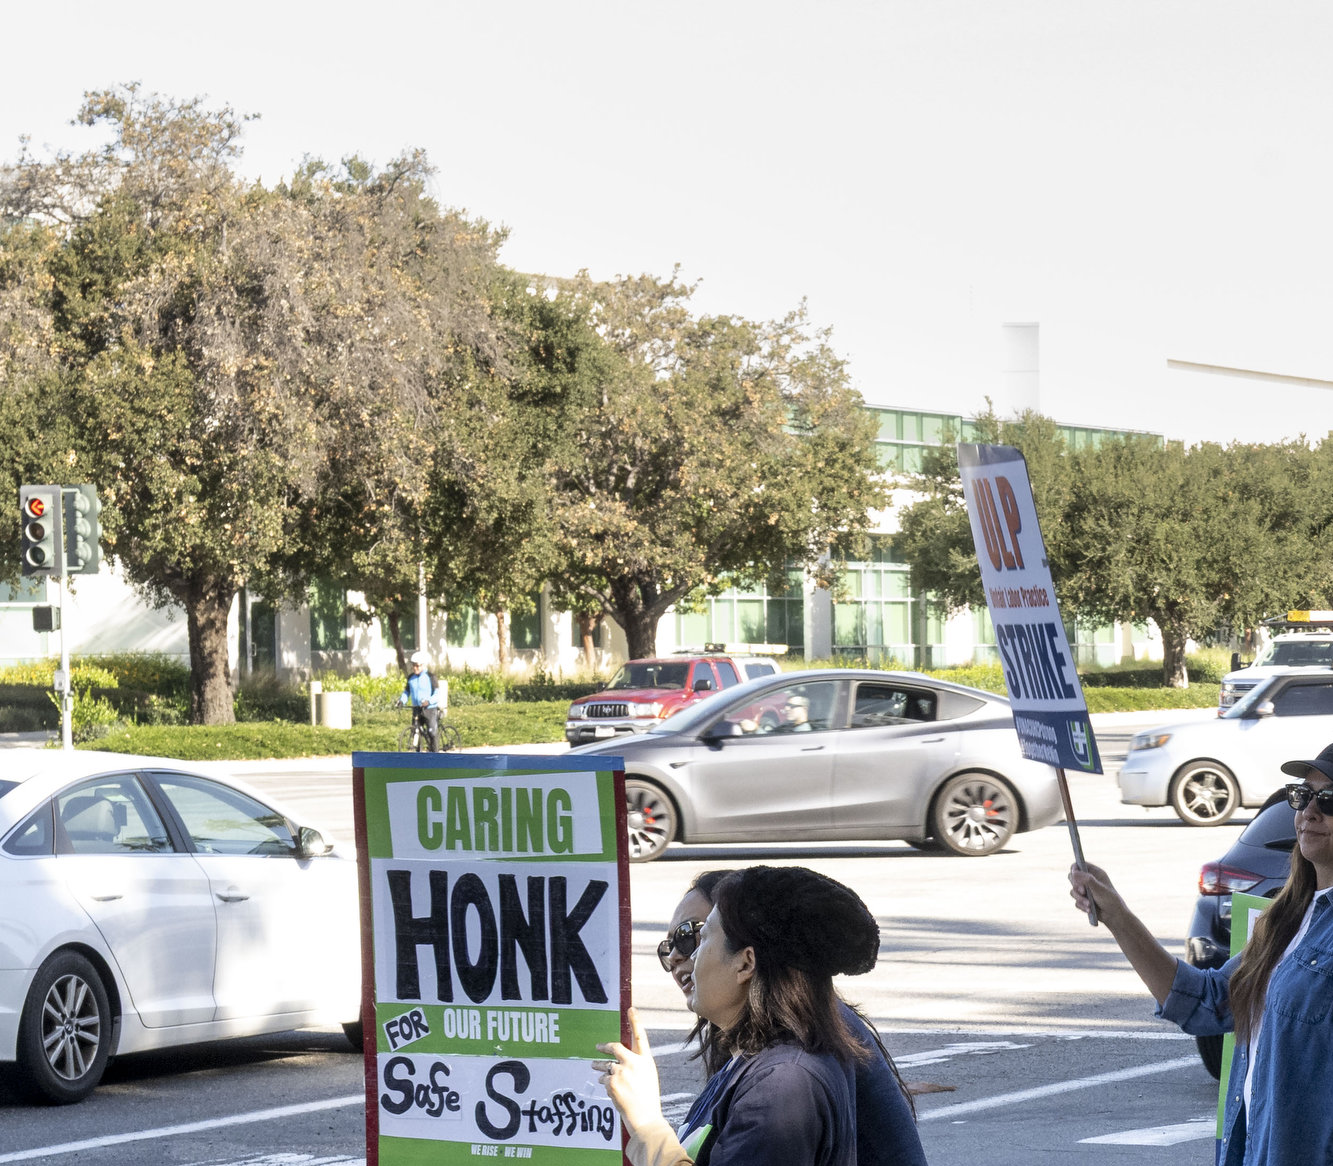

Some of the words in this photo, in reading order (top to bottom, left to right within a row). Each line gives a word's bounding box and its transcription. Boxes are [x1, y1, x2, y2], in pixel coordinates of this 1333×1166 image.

[971, 476, 1025, 572] ULP
[1020, 584, 1049, 608] Practice
[997, 622, 1077, 700] STRIKE
[416, 785, 574, 853] CARING
[387, 870, 609, 1004] HONK
[385, 1011, 429, 1051] FOR
[443, 1008, 481, 1041] OUR
[486, 1011, 561, 1043] FUTURE
[381, 1056, 461, 1118] Safe
[475, 1060, 615, 1141] Staffing
[471, 1144, 482, 1155] WE
[481, 1145, 498, 1156] RISE
[504, 1146, 516, 1158] WE
[516, 1147, 533, 1158] WIN
